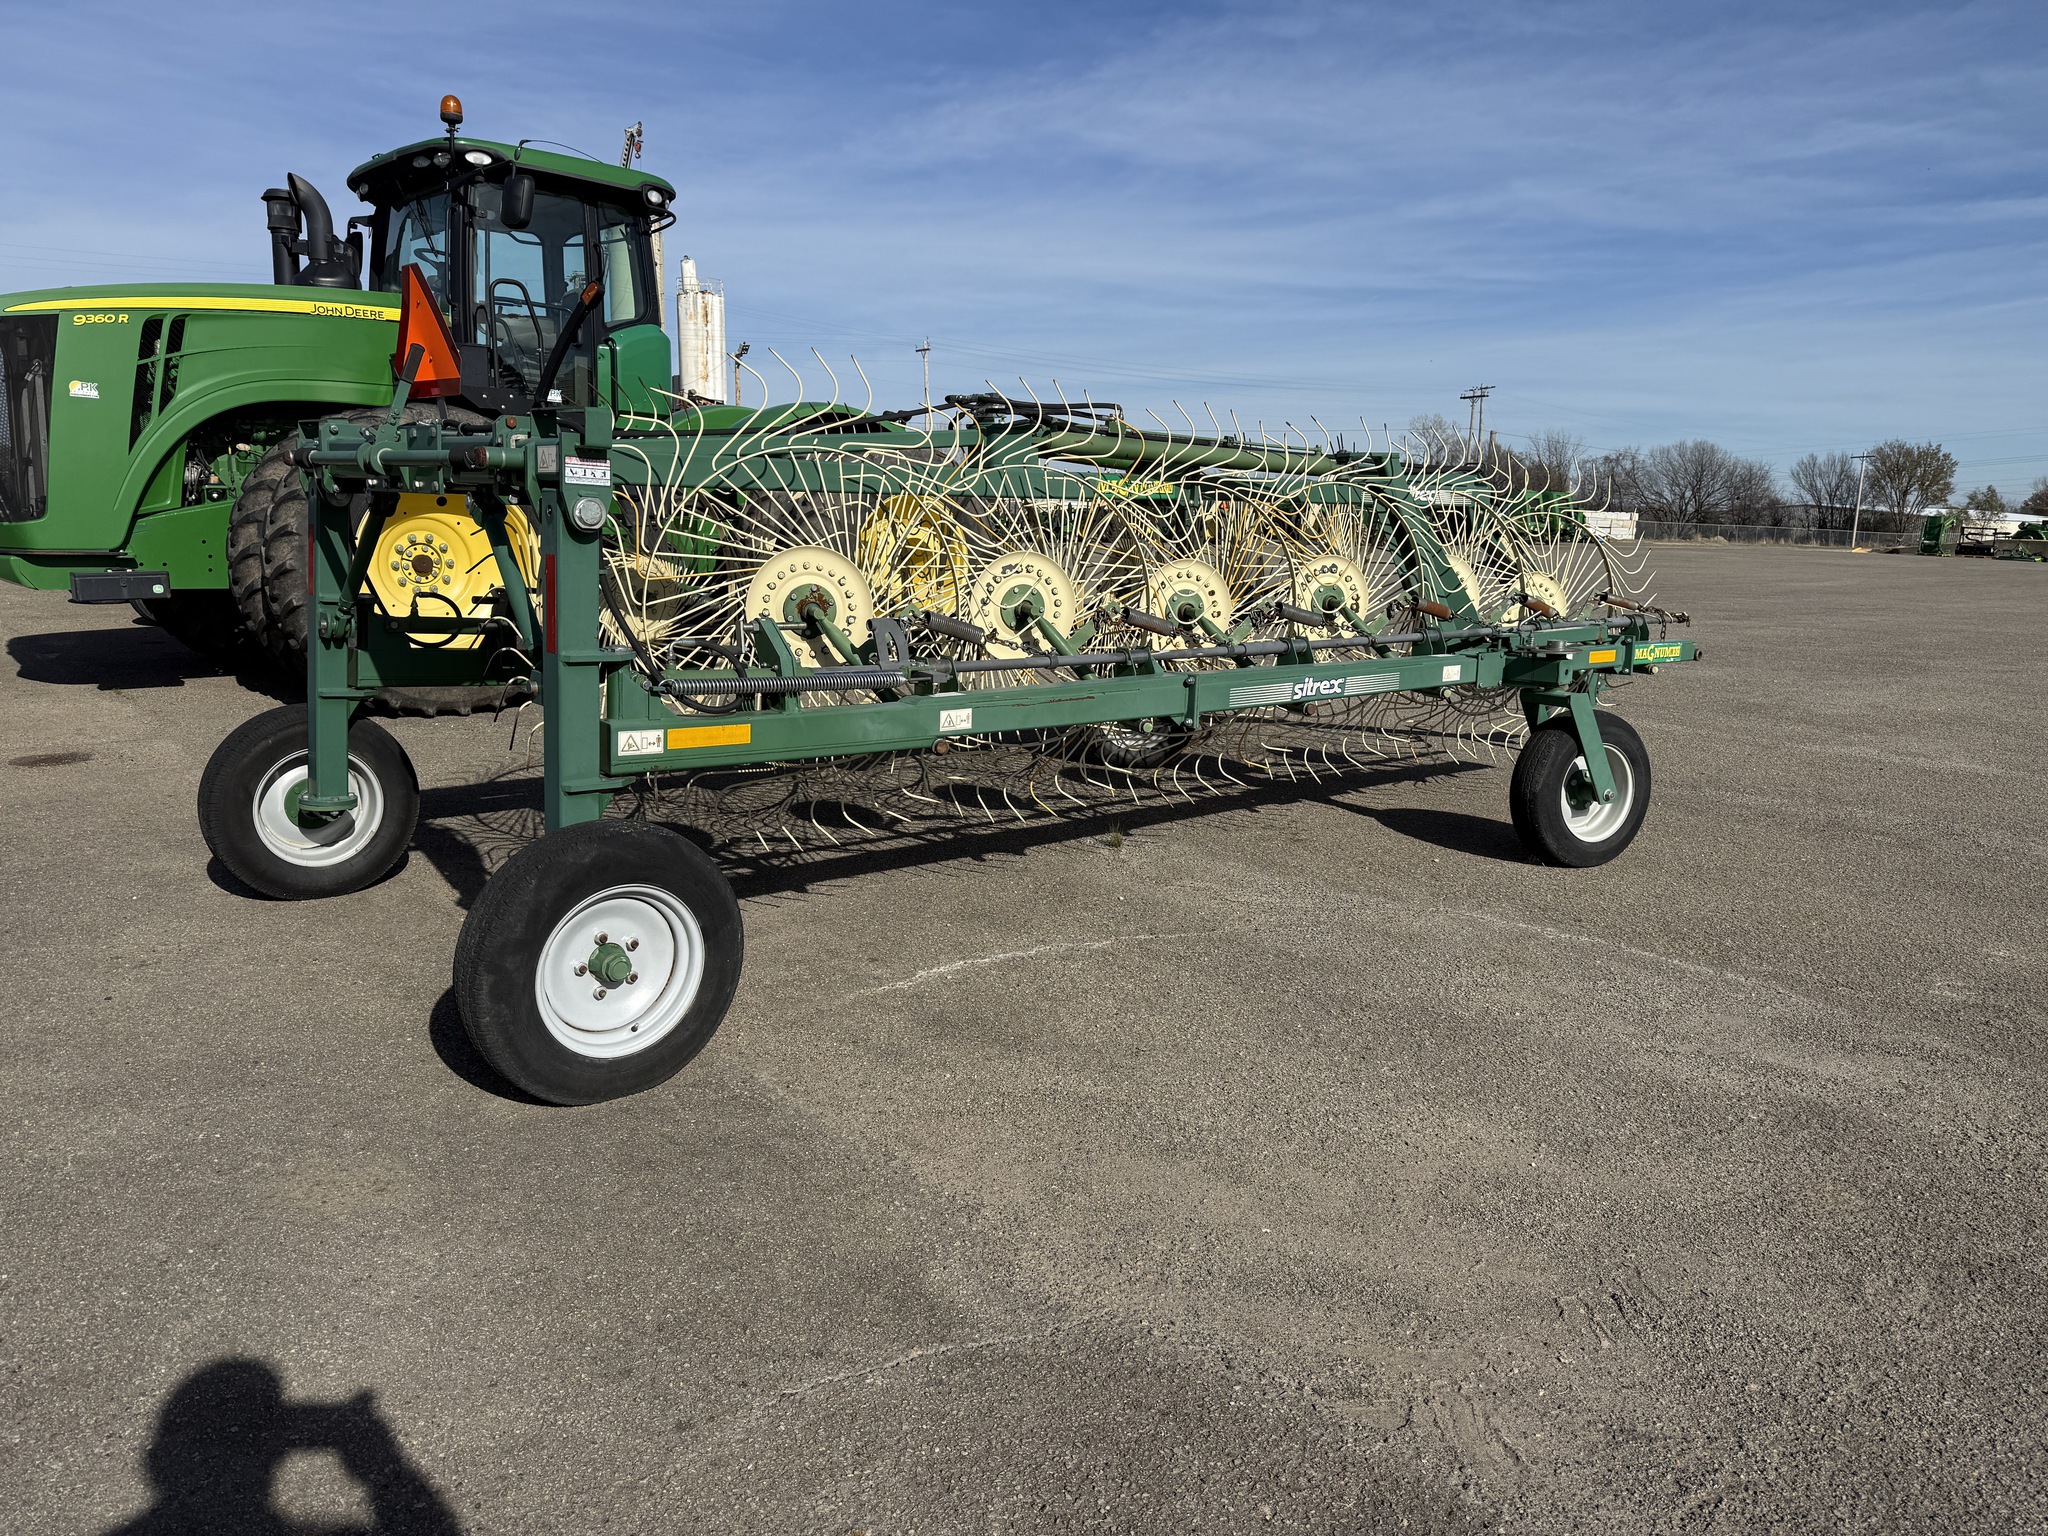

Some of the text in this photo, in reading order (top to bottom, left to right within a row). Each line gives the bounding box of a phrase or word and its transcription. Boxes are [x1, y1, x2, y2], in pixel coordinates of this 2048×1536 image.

[310, 303, 385, 319] JOHN DEERE
[73, 313, 129, 326] 9360 R
[1293, 677, 1344, 700] sitrex
